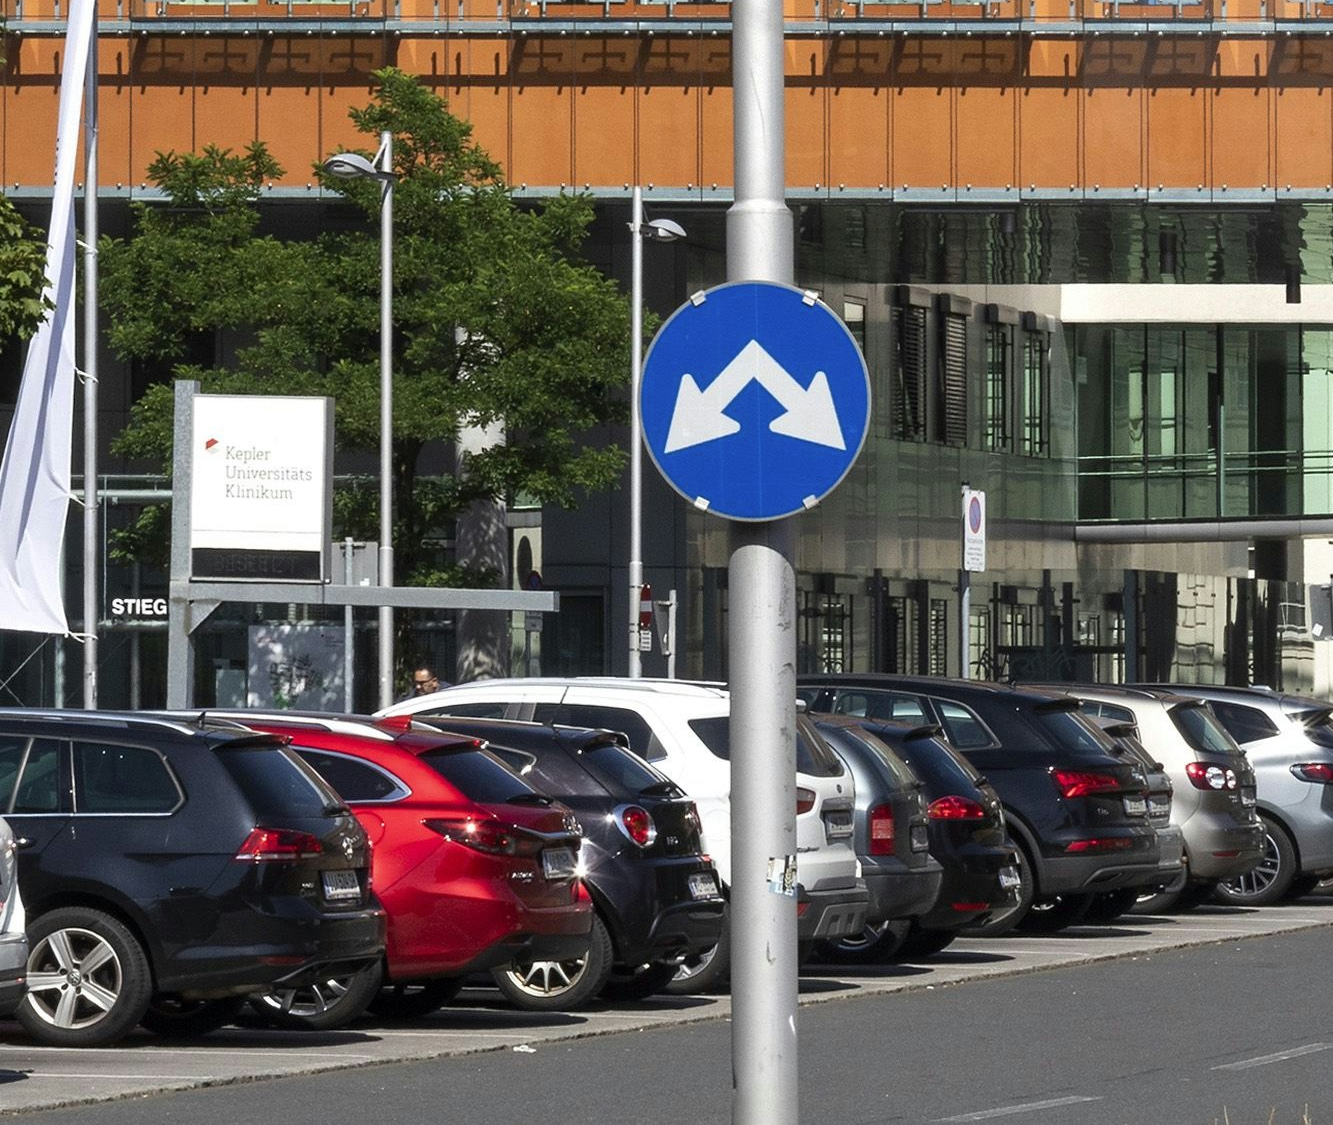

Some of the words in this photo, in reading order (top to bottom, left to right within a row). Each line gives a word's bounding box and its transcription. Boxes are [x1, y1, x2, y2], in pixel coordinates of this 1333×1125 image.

[225, 445, 272, 464] Kepler
[225, 465, 313, 482] Universitäts
[225, 483, 294, 500] Klinikum
[111, 598, 168, 615] STIEG
